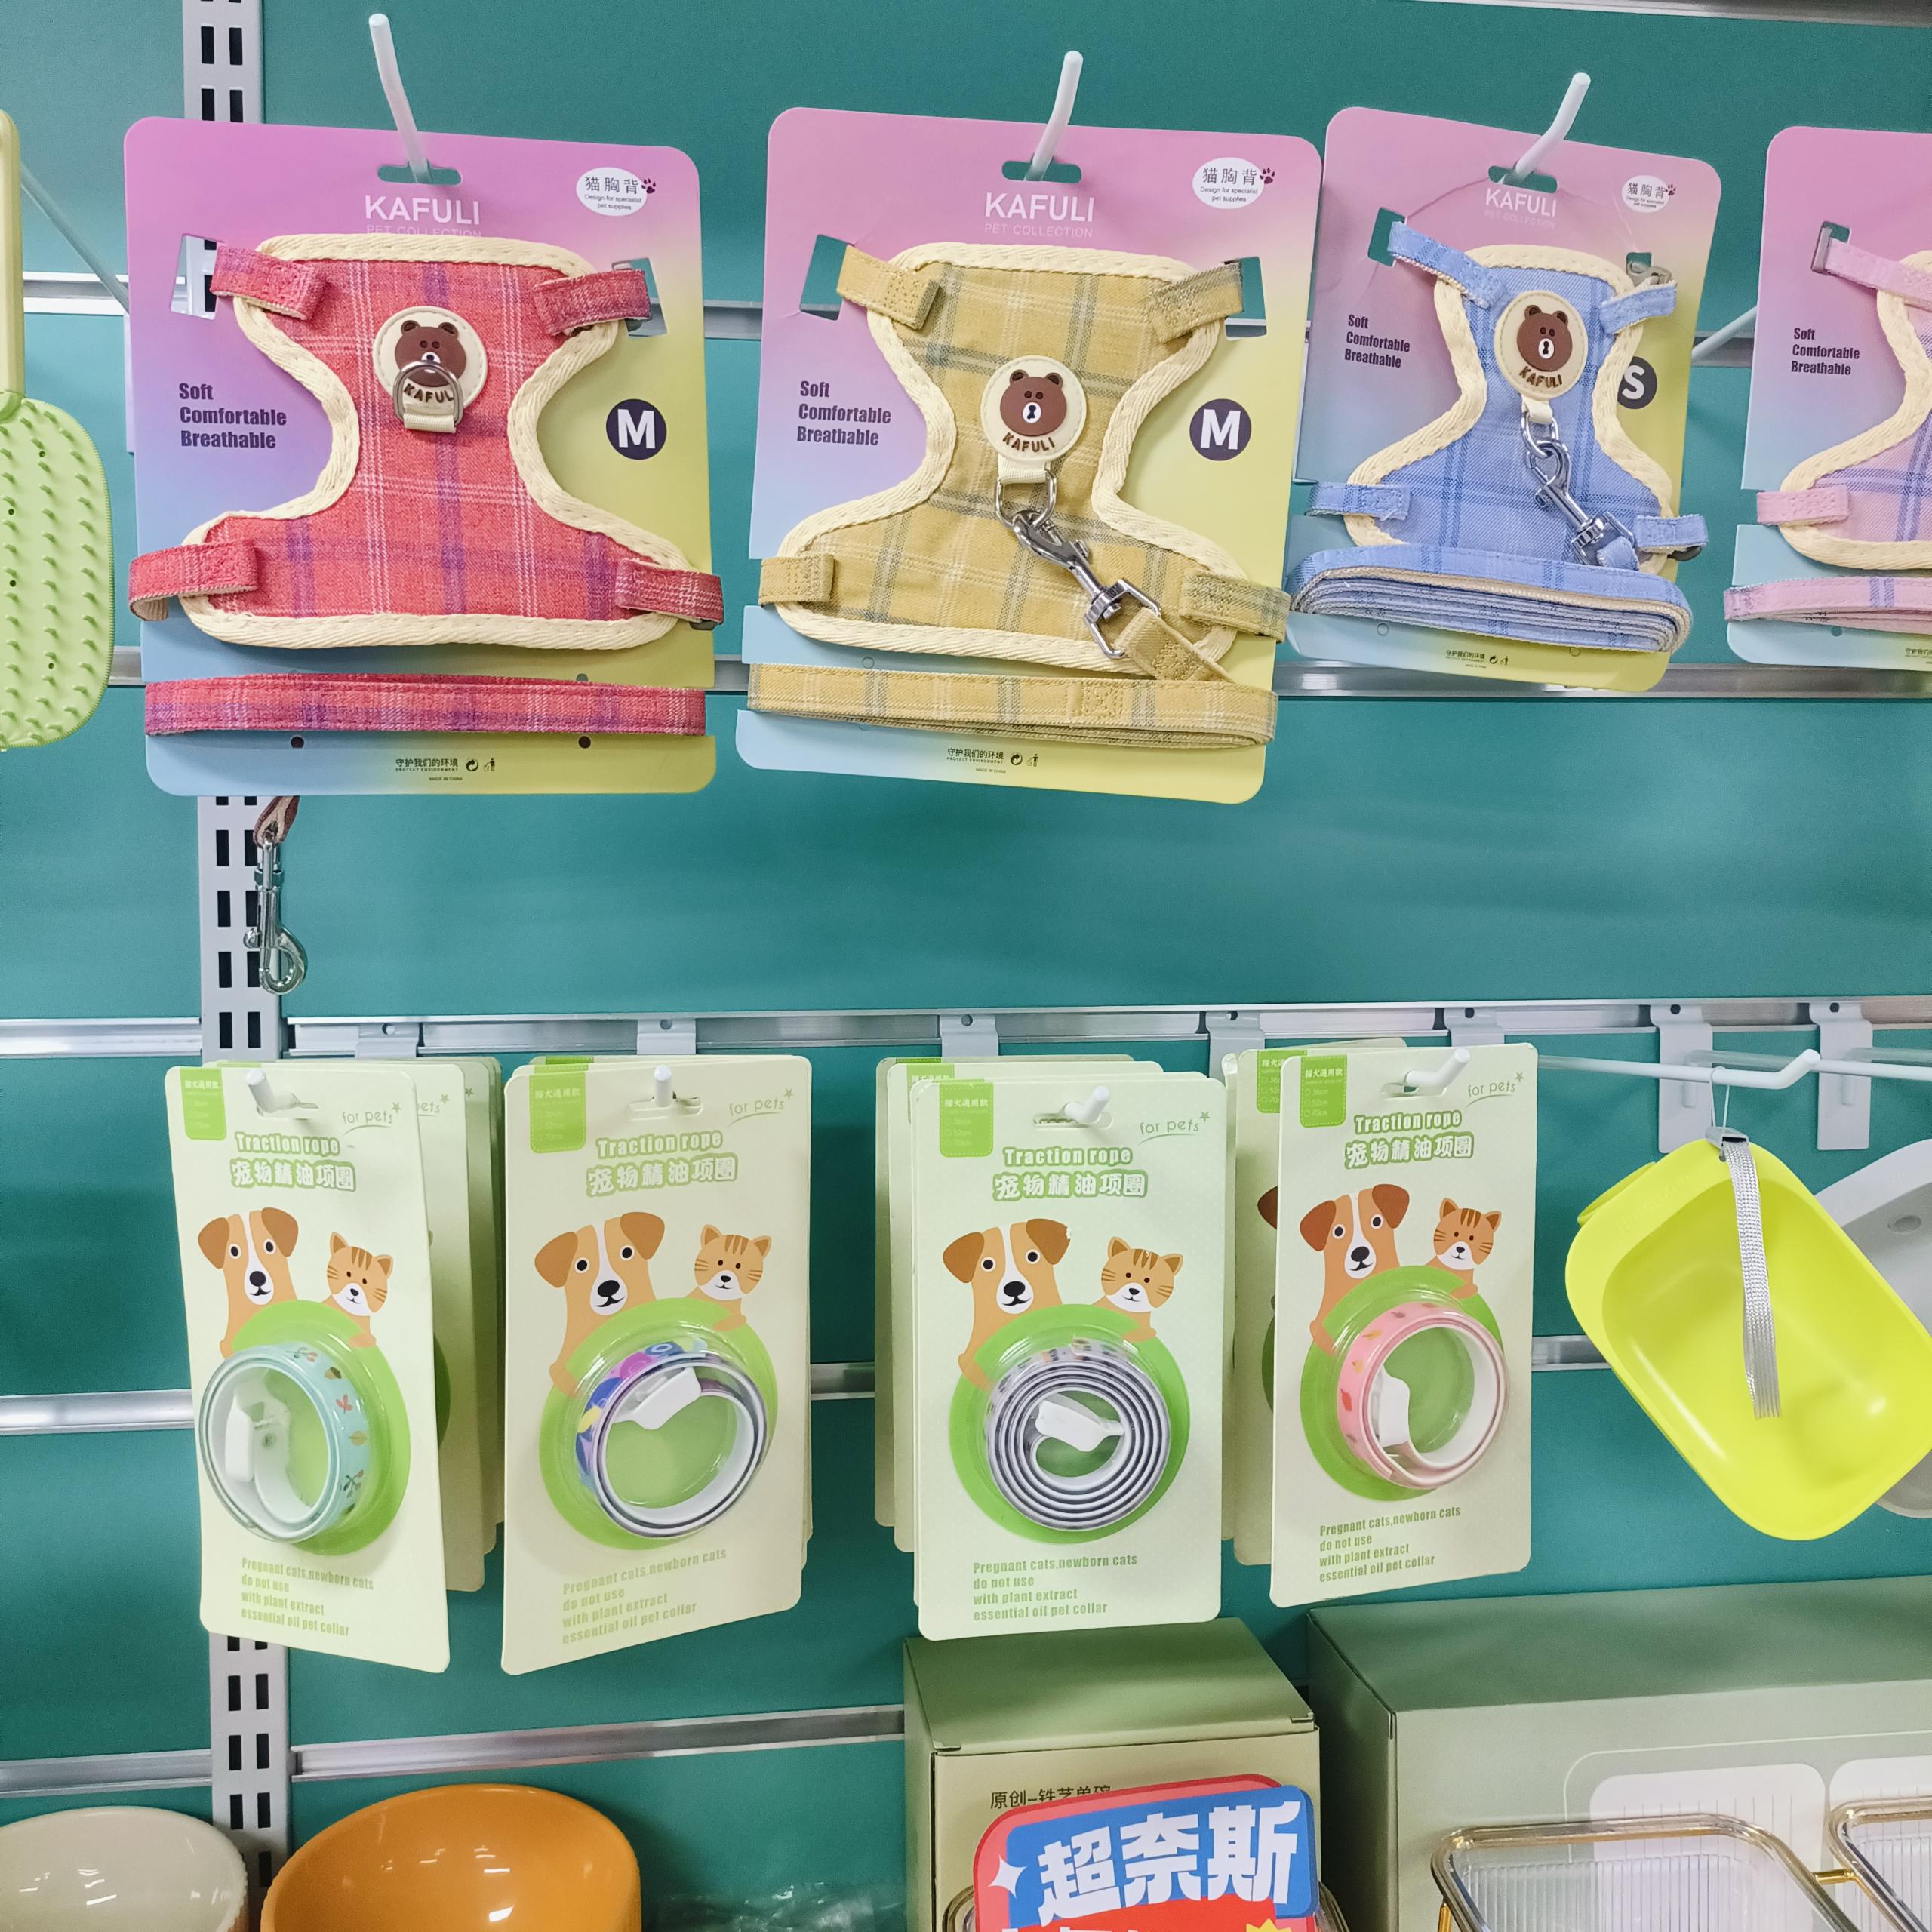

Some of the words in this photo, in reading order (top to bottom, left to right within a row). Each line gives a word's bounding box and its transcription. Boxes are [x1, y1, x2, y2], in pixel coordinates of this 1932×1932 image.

[586, 176, 638, 194] 猫胸背
[1202, 168, 1257, 186] 猫胸背
[1627, 183, 1666, 199] 猫胸背
[365, 195, 480, 225] KAFULI
[985, 192, 1094, 223] KAFULI
[1485, 188, 1557, 217] KAFULI
[984, 223, 1008, 234] PET
[1013, 224, 1093, 238] COLLECTION
[1348, 314, 1368, 329] Soft
[1346, 331, 1410, 352] Comfortable
[1793, 328, 1816, 340] Soft
[1344, 348, 1401, 368] Breathable
[1792, 344, 1860, 359] Comfortable
[1519, 365, 1563, 388] KAFULI
[1791, 361, 1851, 375] Breathable
[179, 383, 214, 400] Soft
[800, 380, 830, 398] Soft
[1622, 365, 1645, 400] S
[404, 383, 454, 403] KAFUL
[180, 406, 287, 426] Comfortable
[798, 403, 891, 424] Comfortable
[617, 408, 656, 449] M
[797, 426, 879, 446] Breathable
[1200, 408, 1241, 450] M
[181, 430, 276, 448] Breathable
[1002, 432, 1055, 452] KAFULI
[395, 758, 459, 768] 守护我们的环境
[947, 748, 1004, 760] 守护我们的环境
[1468, 1084, 1484, 1097] for
[1490, 1081, 1515, 1094] pets
[417, 1102, 441, 1113] ets
[729, 1103, 748, 1116] for
[754, 1097, 784, 1112] pets
[342, 1111, 359, 1124] for
[365, 1110, 393, 1124] pets
[1140, 1122, 1159, 1135] for
[1167, 1119, 1199, 1134] pets
[1354, 1111, 1423, 1134] Traction
[1425, 1109, 1462, 1130] rope
[235, 1132, 301, 1154] Traction
[303, 1136, 340, 1157] rope
[595, 1134, 677, 1159] Traction
[679, 1130, 723, 1151] rope
[1344, 1131, 1474, 1169] 宠物精油项圈
[1002, 1146, 1084, 1167] Traction
[1088, 1147, 1132, 1167] rope
[229, 1157, 356, 1192] 宠物精油项圈
[586, 1152, 738, 1198] 宠物精油项圈
[992, 1168, 1149, 1201] 宠物精油项圈
[1320, 1519, 1366, 1537] Pregnant
[1439, 1506, 1461, 1518] cats
[1320, 1540, 1332, 1552] do
[1335, 1537, 1351, 1549] not
[1354, 1535, 1372, 1546] use
[973, 1561, 1026, 1574] Pregnant
[1112, 1555, 1137, 1566] cats
[1319, 1554, 1341, 1567] with
[1344, 1549, 1371, 1564] plant
[1374, 1543, 1409, 1558] extract
[242, 1557, 284, 1576] Pregnant
[352, 1577, 374, 1590] cats
[563, 1572, 617, 1595] Pregnant
[703, 1549, 727, 1564] cats
[1319, 1564, 1367, 1582] essential
[1370, 1562, 1383, 1574] oil
[1386, 1560, 1402, 1573] pet
[1405, 1555, 1435, 1569] collar
[242, 1574, 253, 1586] do
[255, 1576, 270, 1589] not
[272, 1580, 290, 1592] use
[974, 1578, 987, 1589] do
[991, 1577, 1010, 1589] not
[1013, 1577, 1034, 1587] use
[242, 1591, 261, 1604] with
[263, 1594, 288, 1609] plant
[291, 1599, 325, 1616] extract
[563, 1598, 577, 1611] do
[581, 1593, 600, 1607] not
[603, 1588, 625, 1602] use
[974, 1593, 998, 1605] with
[1002, 1591, 1032, 1604] plant
[1035, 1589, 1078, 1601] extract
[562, 1612, 588, 1629] with
[592, 1604, 623, 1623] plant
[626, 1593, 668, 1611] extract
[974, 1607, 1029, 1621] essential
[1032, 1605, 1048, 1617] oil
[1051, 1604, 1069, 1617] pet
[1072, 1602, 1107, 1615] collar
[242, 1608, 285, 1626] essential
[287, 1615, 300, 1628] oil
[302, 1619, 318, 1632] pet
[320, 1622, 349, 1637] collar
[562, 1620, 619, 1644] essential
[622, 1615, 637, 1630] oil
[641, 1611, 660, 1626] pet
[663, 1603, 697, 1620] collar
[1037, 1801, 1301, 1927] 超奈斯
